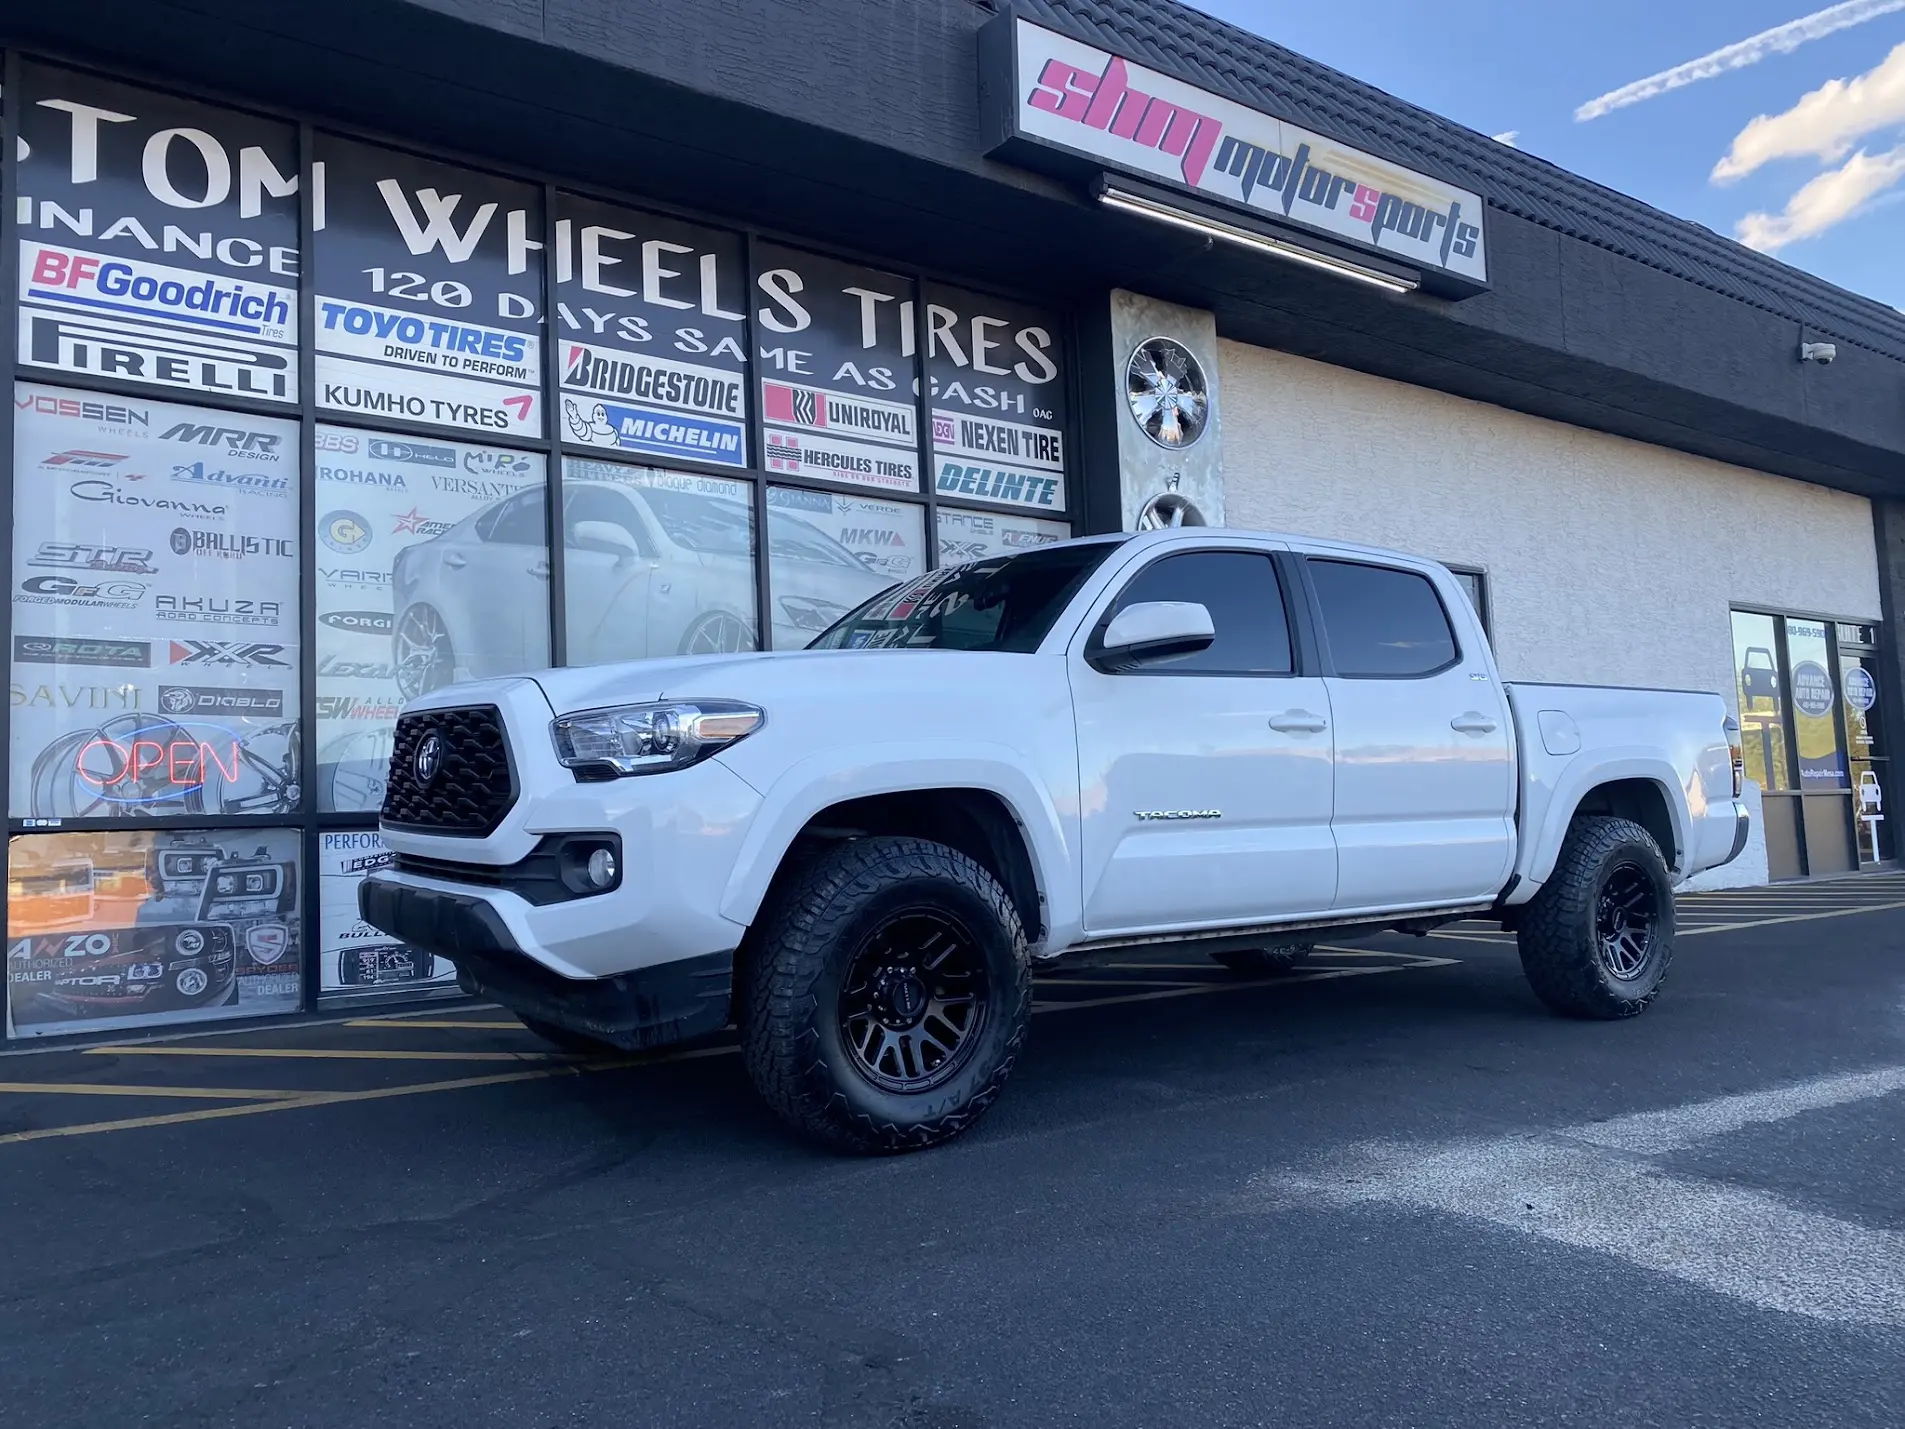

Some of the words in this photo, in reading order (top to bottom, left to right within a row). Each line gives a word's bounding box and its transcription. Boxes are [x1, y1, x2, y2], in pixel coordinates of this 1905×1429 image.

[1213, 135, 1480, 268] motorsports
[31, 249, 290, 325] BFGoodrich
[376, 178, 811, 333] WHEELS
[842, 287, 1058, 384] TIRES
[261, 324, 285, 339] Tires
[362, 267, 473, 308] 120
[499, 293, 654, 343] DAYS
[674, 328, 814, 376] SAME
[833, 362, 897, 391] AS
[912, 376, 1025, 413] CASH
[32, 316, 288, 397] PIRELLI
[384, 344, 438, 366] DRIVEN
[441, 353, 459, 369] TO
[463, 357, 528, 381] PERFORM
[563, 345, 740, 414] BRIDGESTONE
[14, 395, 149, 427] VOSSEN
[324, 383, 426, 417] KUMHO
[434, 401, 509, 429] TYRES
[829, 402, 911, 436] UNIROYAL
[98, 426, 149, 438] WHEELS
[158, 423, 283, 454] MRR
[620, 416, 739, 453] MICHELIN
[961, 420, 1019, 456] NEXEN
[1022, 431, 1060, 462] TIRE
[228, 449, 279, 462] DESIGN
[804, 448, 872, 473] HERCULES
[875, 461, 912, 479] TIRES
[320, 465, 407, 487] ROHANA
[937, 463, 1058, 505] DELINTE
[70, 480, 226, 515] Giovanna
[859, 503, 901, 513] VERDE
[192, 530, 294, 558] BALLISTIC
[840, 528, 893, 546] MKW
[156, 595, 280, 615] AKUZA
[156, 612, 197, 620] ROAD
[203, 614, 279, 625] CONCEPTS
[52, 642, 142, 656] ROTA
[9, 682, 143, 710] SAVINI
[197, 695, 281, 708] DIABLO
[76, 741, 239, 785] OPEN
[1133, 809, 1221, 820] TACOMA
[257, 984, 299, 996] DEALER
